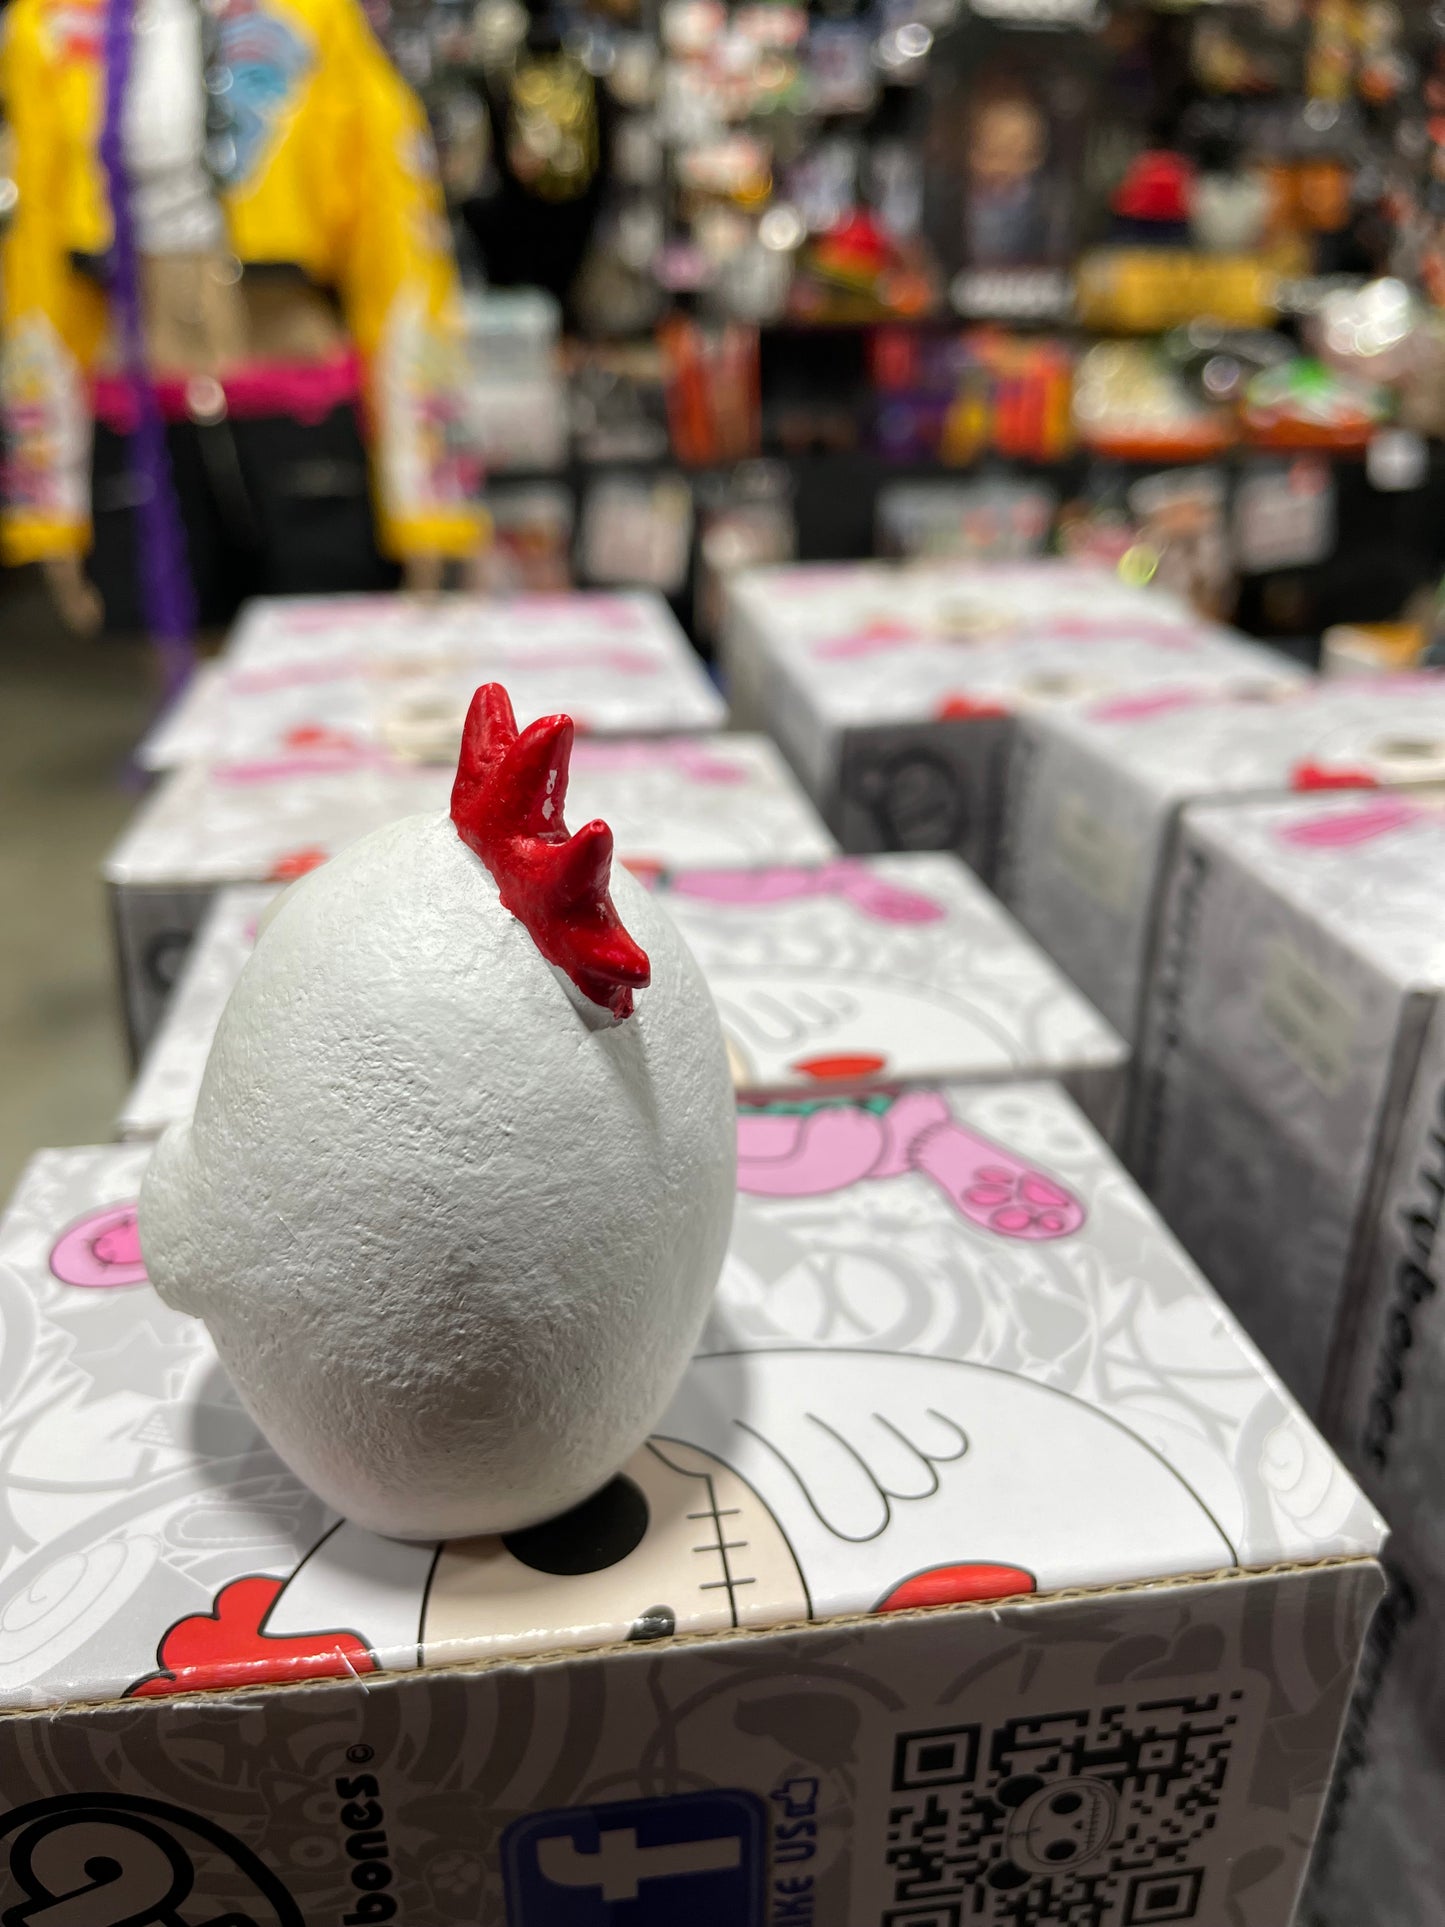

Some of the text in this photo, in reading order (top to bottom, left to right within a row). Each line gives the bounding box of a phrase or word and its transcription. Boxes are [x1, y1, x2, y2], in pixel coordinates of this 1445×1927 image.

[336, 1774, 397, 1927] bones
[773, 1820, 817, 1927] IKE US
